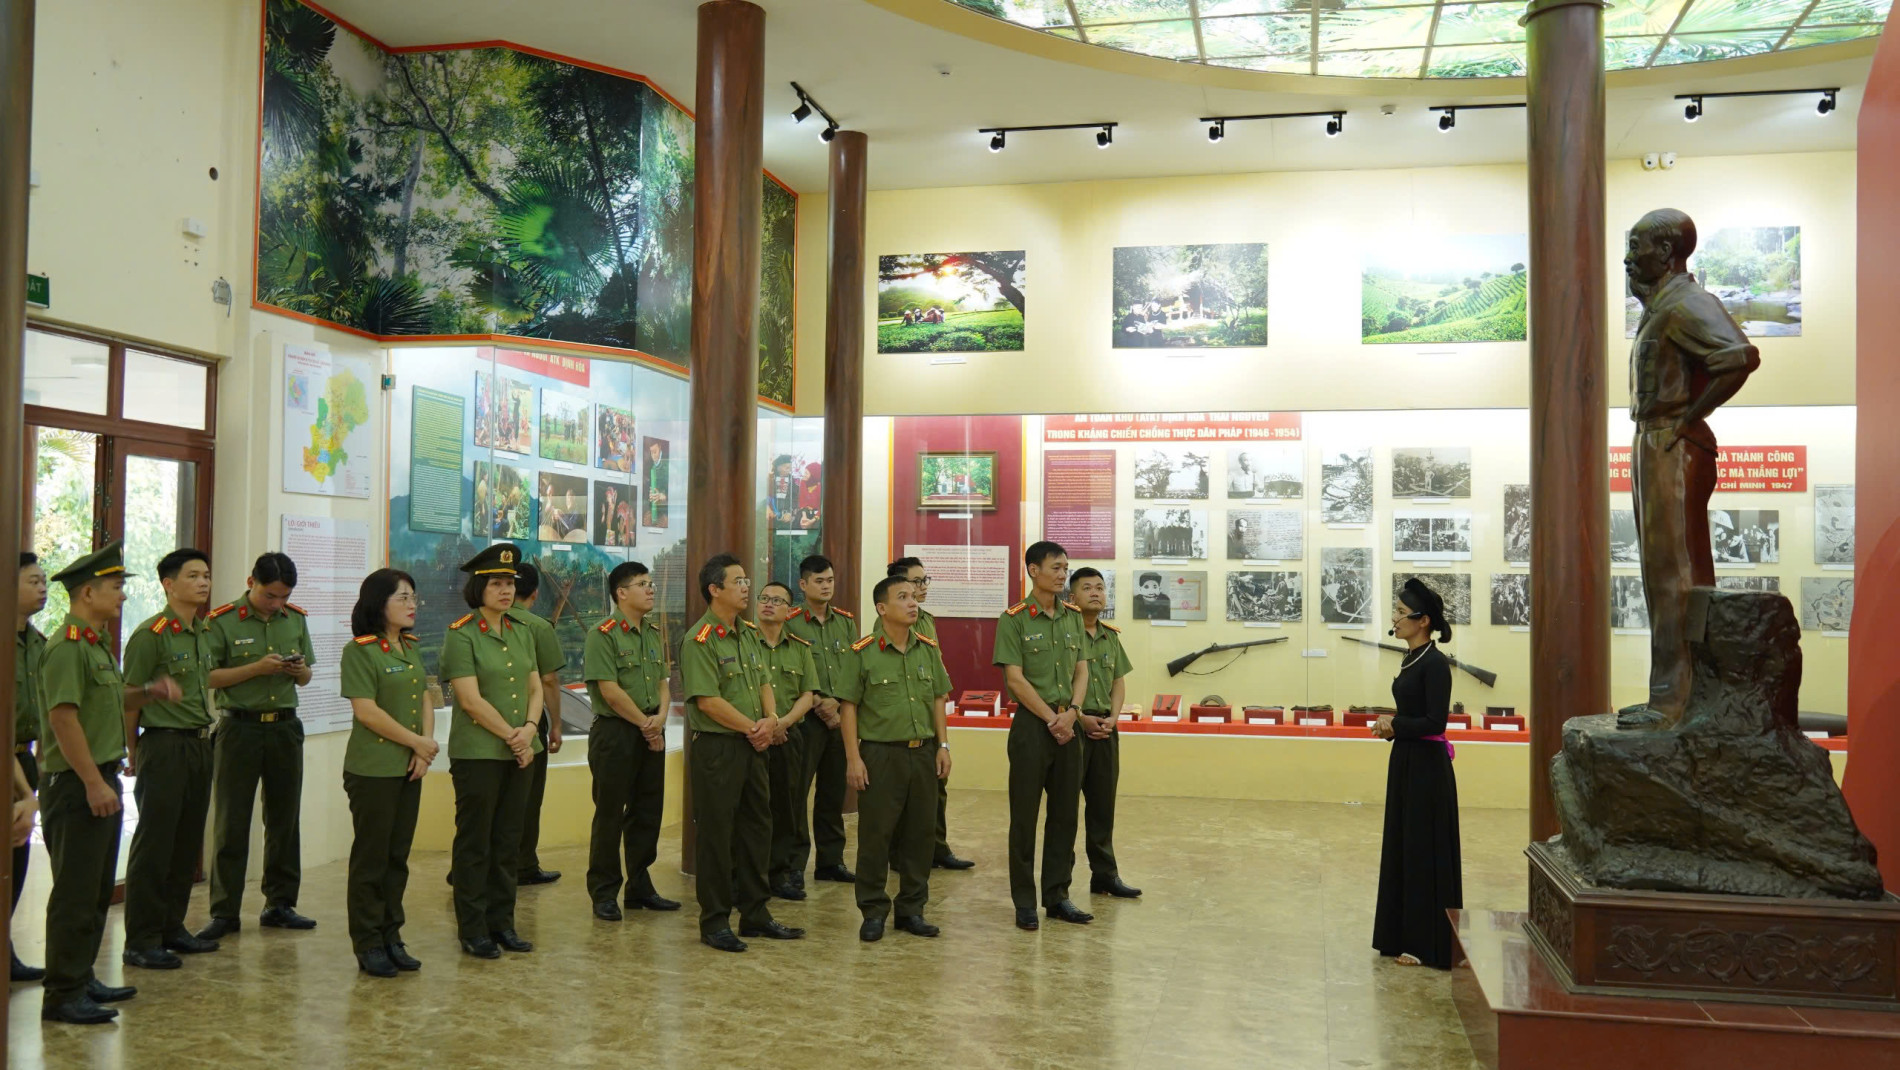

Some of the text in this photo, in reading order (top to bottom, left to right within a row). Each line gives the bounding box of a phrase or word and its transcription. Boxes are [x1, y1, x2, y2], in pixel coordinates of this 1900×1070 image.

[1047, 429, 1076, 439] TRONG
[1077, 427, 1109, 439] KHÁNG
[1110, 425, 1137, 439] CHIẾN
[1139, 424, 1170, 438] CHỐNG
[1172, 427, 1196, 440] THỰC
[1197, 426, 1217, 438] DÂN
[1218, 426, 1243, 438] PHÁP
[1731, 449, 1764, 463] THÀNH
[1767, 450, 1795, 463] CÔNG
[1729, 466, 1745, 478] MÀ
[1747, 464, 1779, 478] THẮNG
